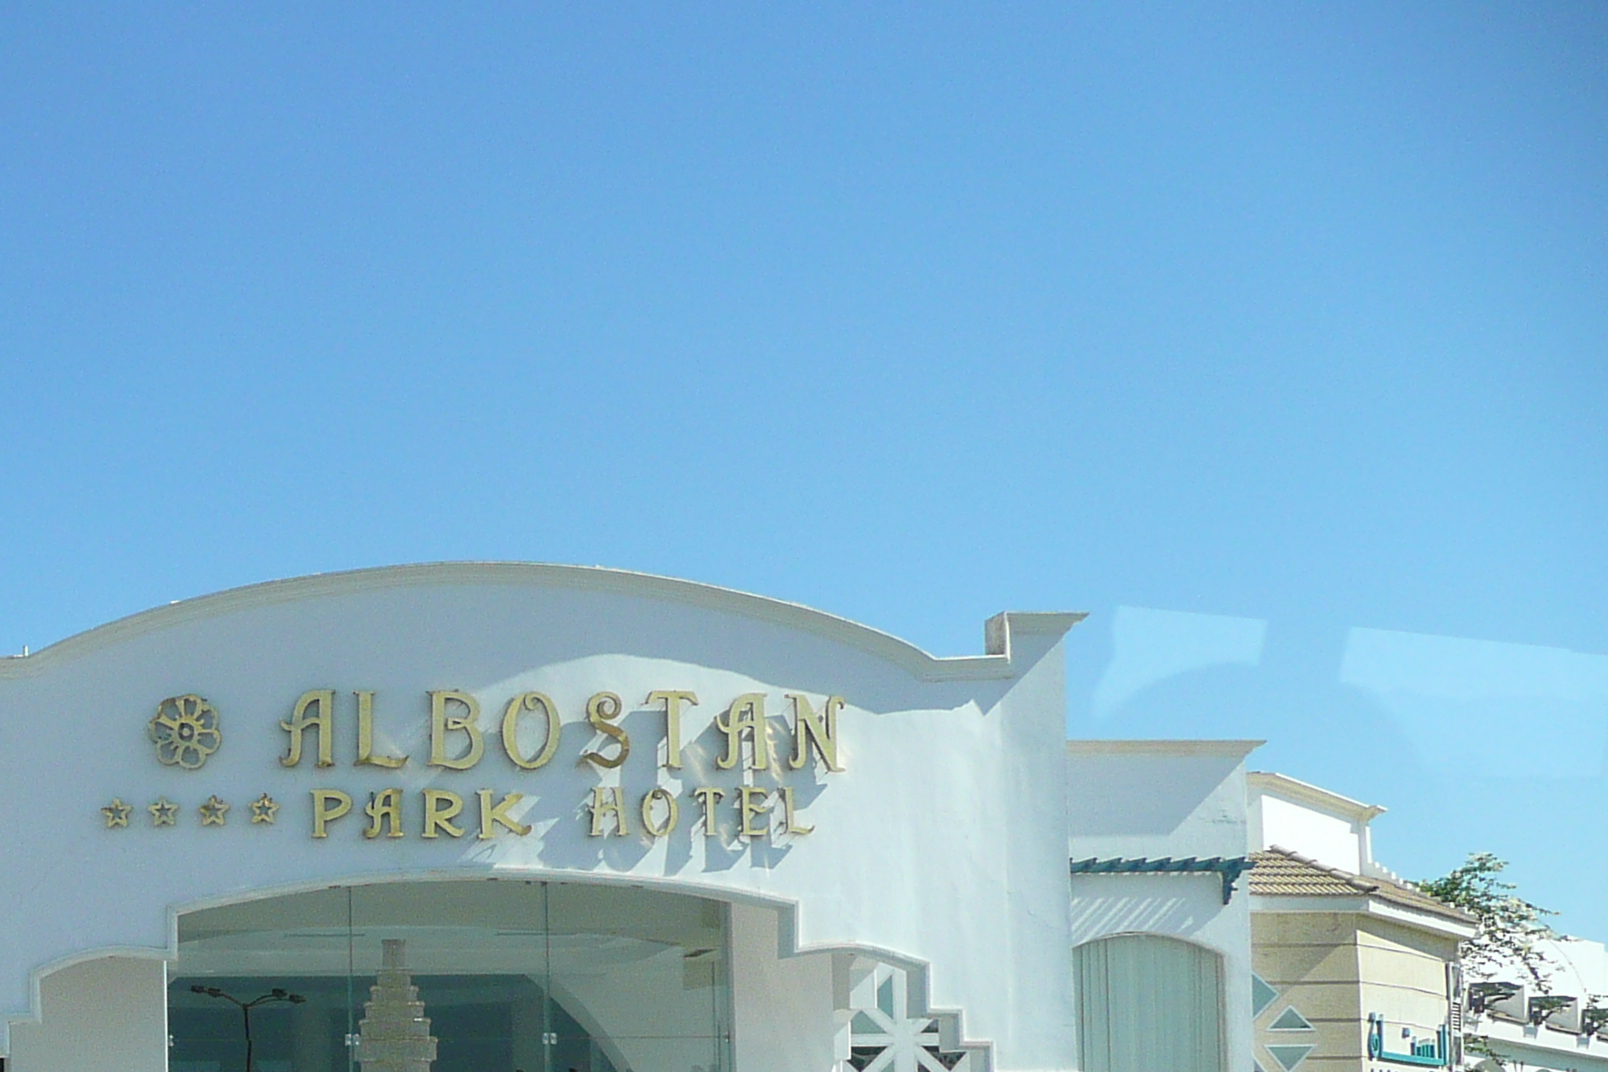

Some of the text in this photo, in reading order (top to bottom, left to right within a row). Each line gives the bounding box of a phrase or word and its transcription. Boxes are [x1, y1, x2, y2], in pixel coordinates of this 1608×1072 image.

[278, 688, 846, 774] ALBOSTAN
[311, 785, 817, 841] PARK HOTEL
